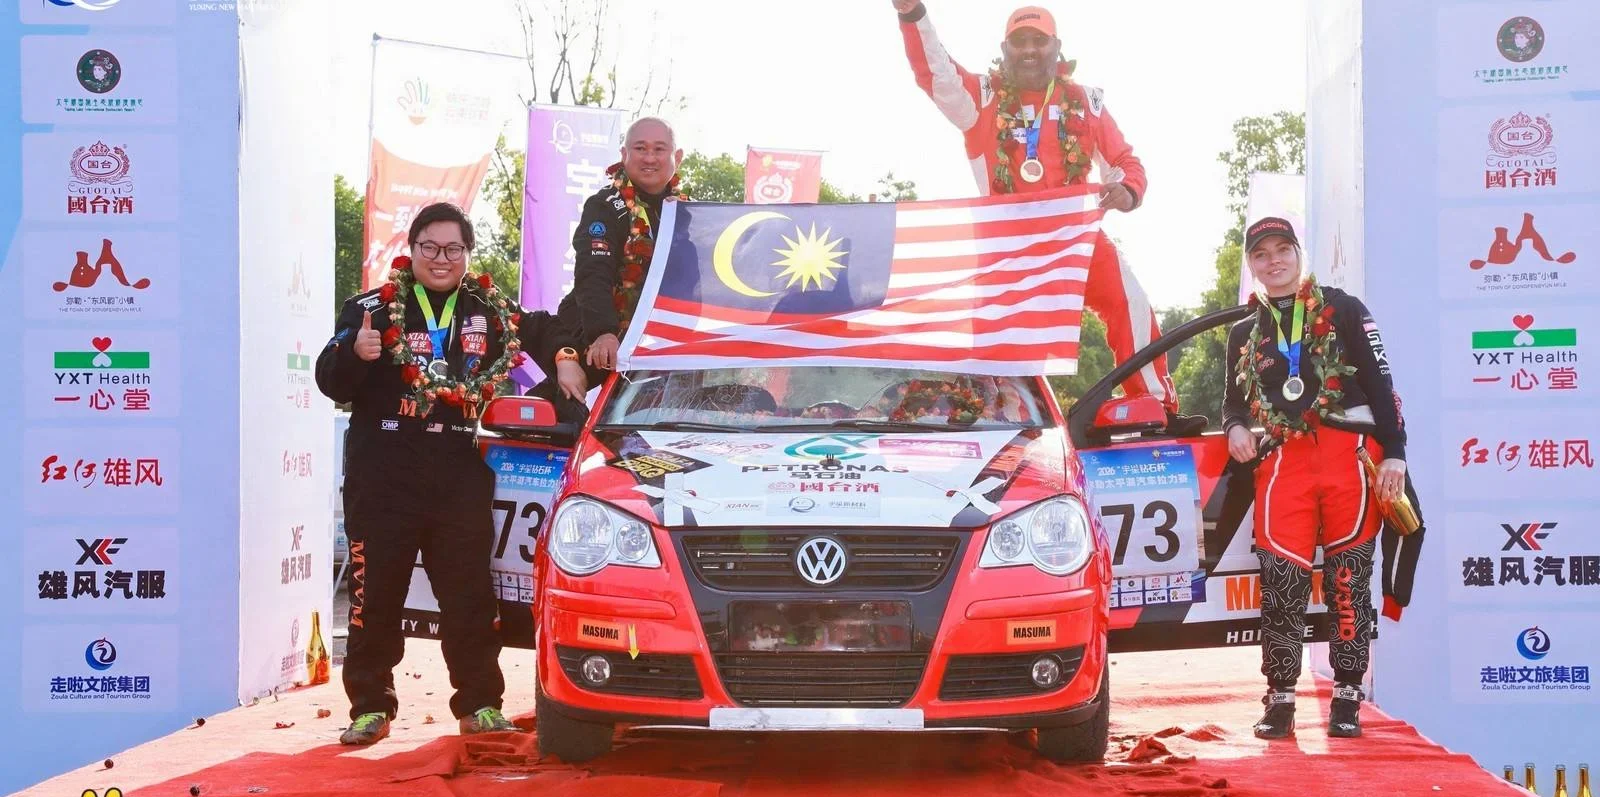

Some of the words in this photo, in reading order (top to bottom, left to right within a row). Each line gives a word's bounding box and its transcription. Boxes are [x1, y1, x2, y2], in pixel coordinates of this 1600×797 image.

[1498, 159, 1544, 168] GUOTAI
[1486, 167, 1557, 188] 國台酒
[68, 196, 133, 214] 國台酒
[1473, 352, 1514, 365] YXT
[1522, 351, 1577, 364] Health
[54, 373, 93, 384] YXT
[100, 373, 150, 384] Health
[1473, 367, 1578, 390] 一心堂
[54, 388, 150, 410] 一心堂
[1462, 438, 1594, 472] 红河雄风
[42, 456, 163, 488] 红河雄风
[742, 464, 909, 473] PETRONAS
[492, 500, 545, 564] 73
[1100, 500, 1181, 566] 73
[1462, 556, 1600, 586] 雄风汽服
[38, 570, 166, 600] 雄风汽服
[582, 624, 618, 640] MASUMA
[1014, 626, 1051, 638] MASUMA
[1480, 666, 1590, 683] 走啦文旅集团
[50, 676, 150, 693] 走啦文旅集团
